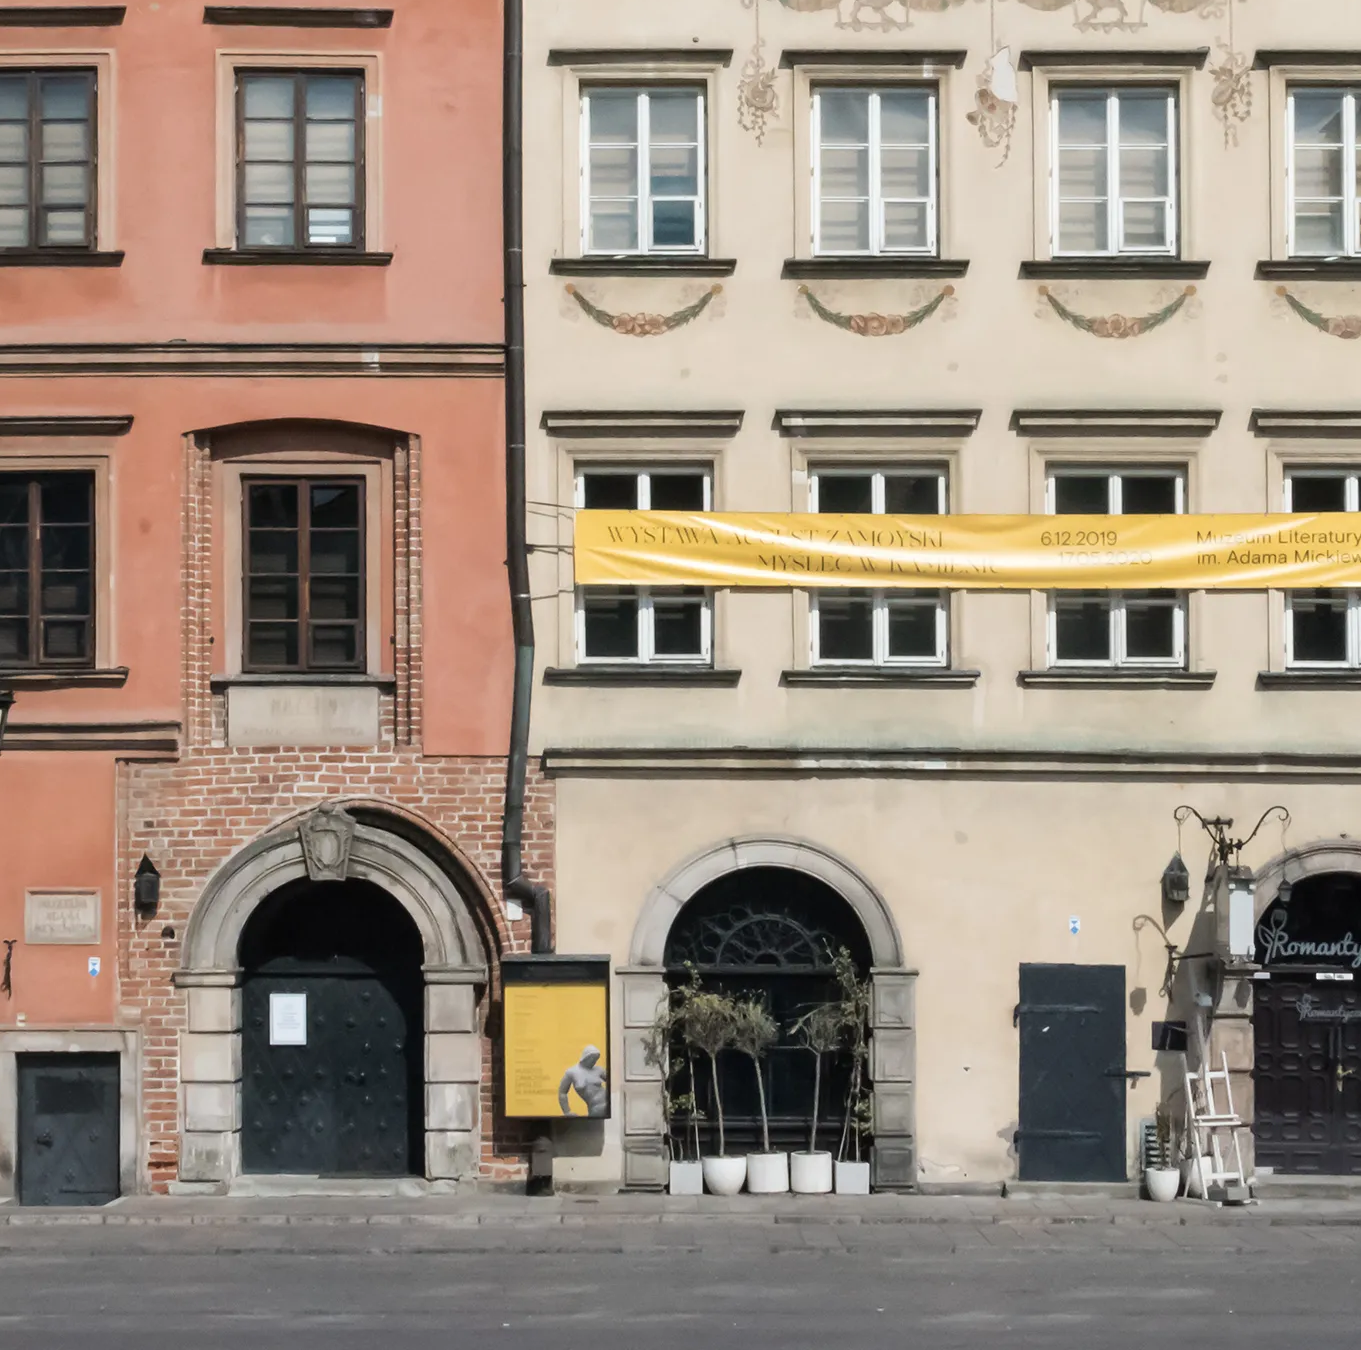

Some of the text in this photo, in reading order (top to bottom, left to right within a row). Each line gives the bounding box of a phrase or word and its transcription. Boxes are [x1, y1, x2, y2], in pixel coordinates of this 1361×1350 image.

[607, 526, 718, 543] WYSTAWA
[1196, 530, 1272, 545] Muzeum
[1197, 552, 1221, 565] im.
[1226, 550, 1288, 565] Adama
